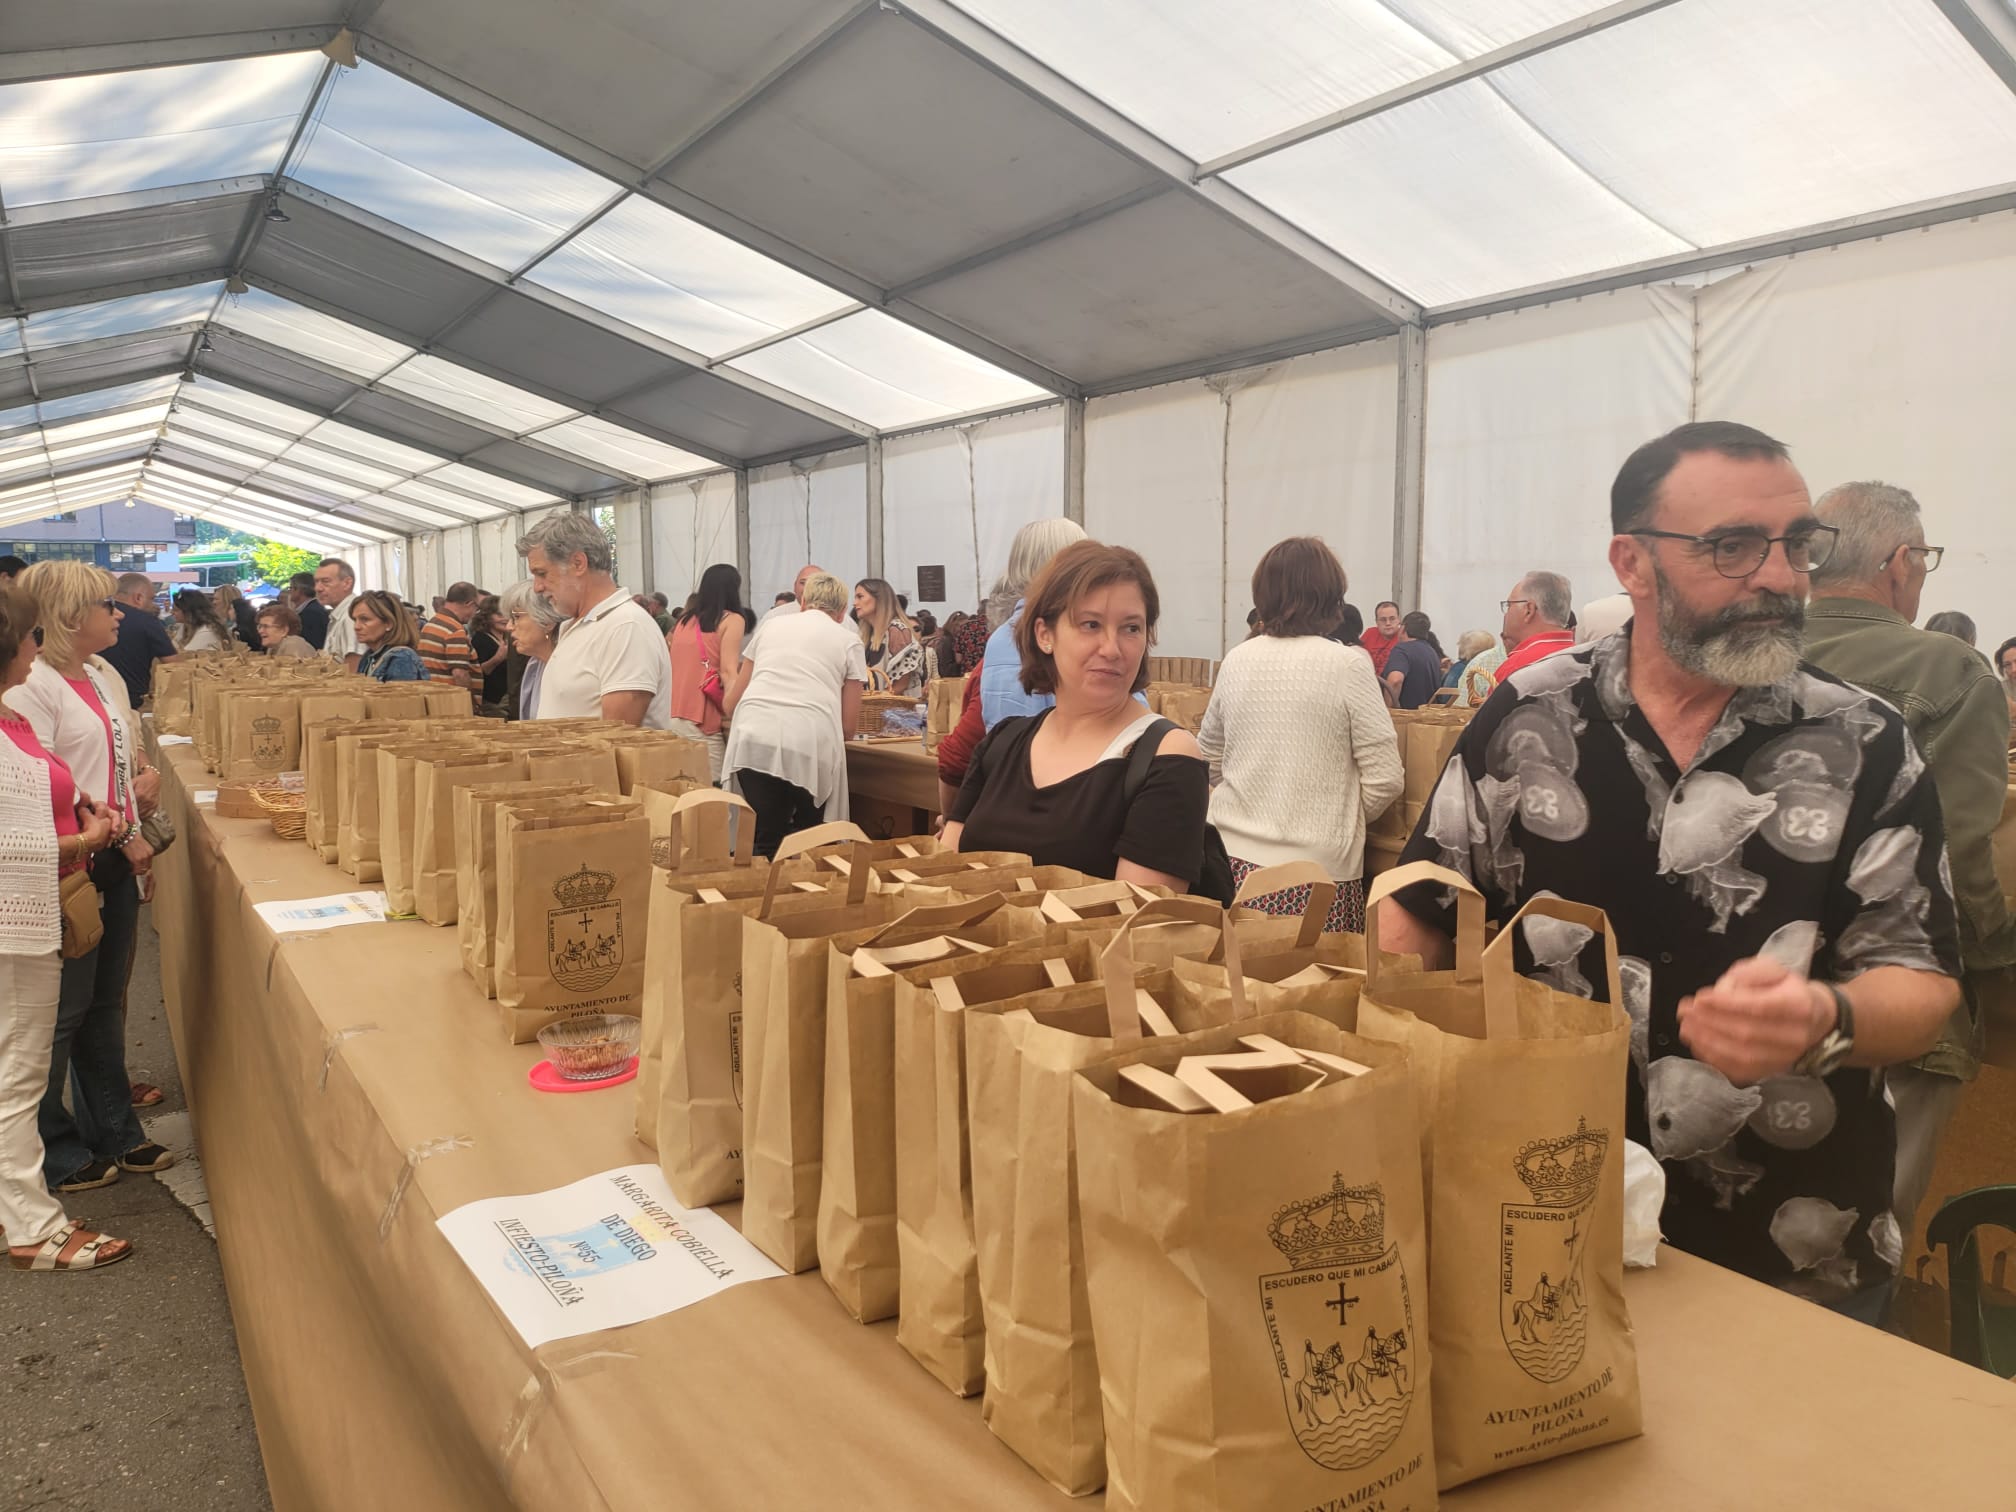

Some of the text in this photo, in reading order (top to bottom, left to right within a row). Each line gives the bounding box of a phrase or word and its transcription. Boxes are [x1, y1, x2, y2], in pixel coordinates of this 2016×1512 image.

[111, 718, 124, 749] LOLA
[544, 993, 631, 1012] AYUNTAMIENTO DE
[600, 1212, 658, 1261] DE DIEGO
[609, 1174, 736, 1281] MARGARITA COBIELLA
[1507, 1209, 1566, 1221] ESCUDERO
[498, 1217, 586, 1307] INFIESTO-PILOÑA
[1264, 1249, 1399, 1290] ESCUDERO QUE MI CABALLO
[1503, 1224, 1514, 1295] ADELANTE MI
[1264, 1296, 1291, 1379] ADELANTE MI
[1484, 1366, 1614, 1425] AYUNTAMIENTO DE
[1531, 1407, 1585, 1436] PILOÑA
[1407, 1452, 1424, 1475] DE
